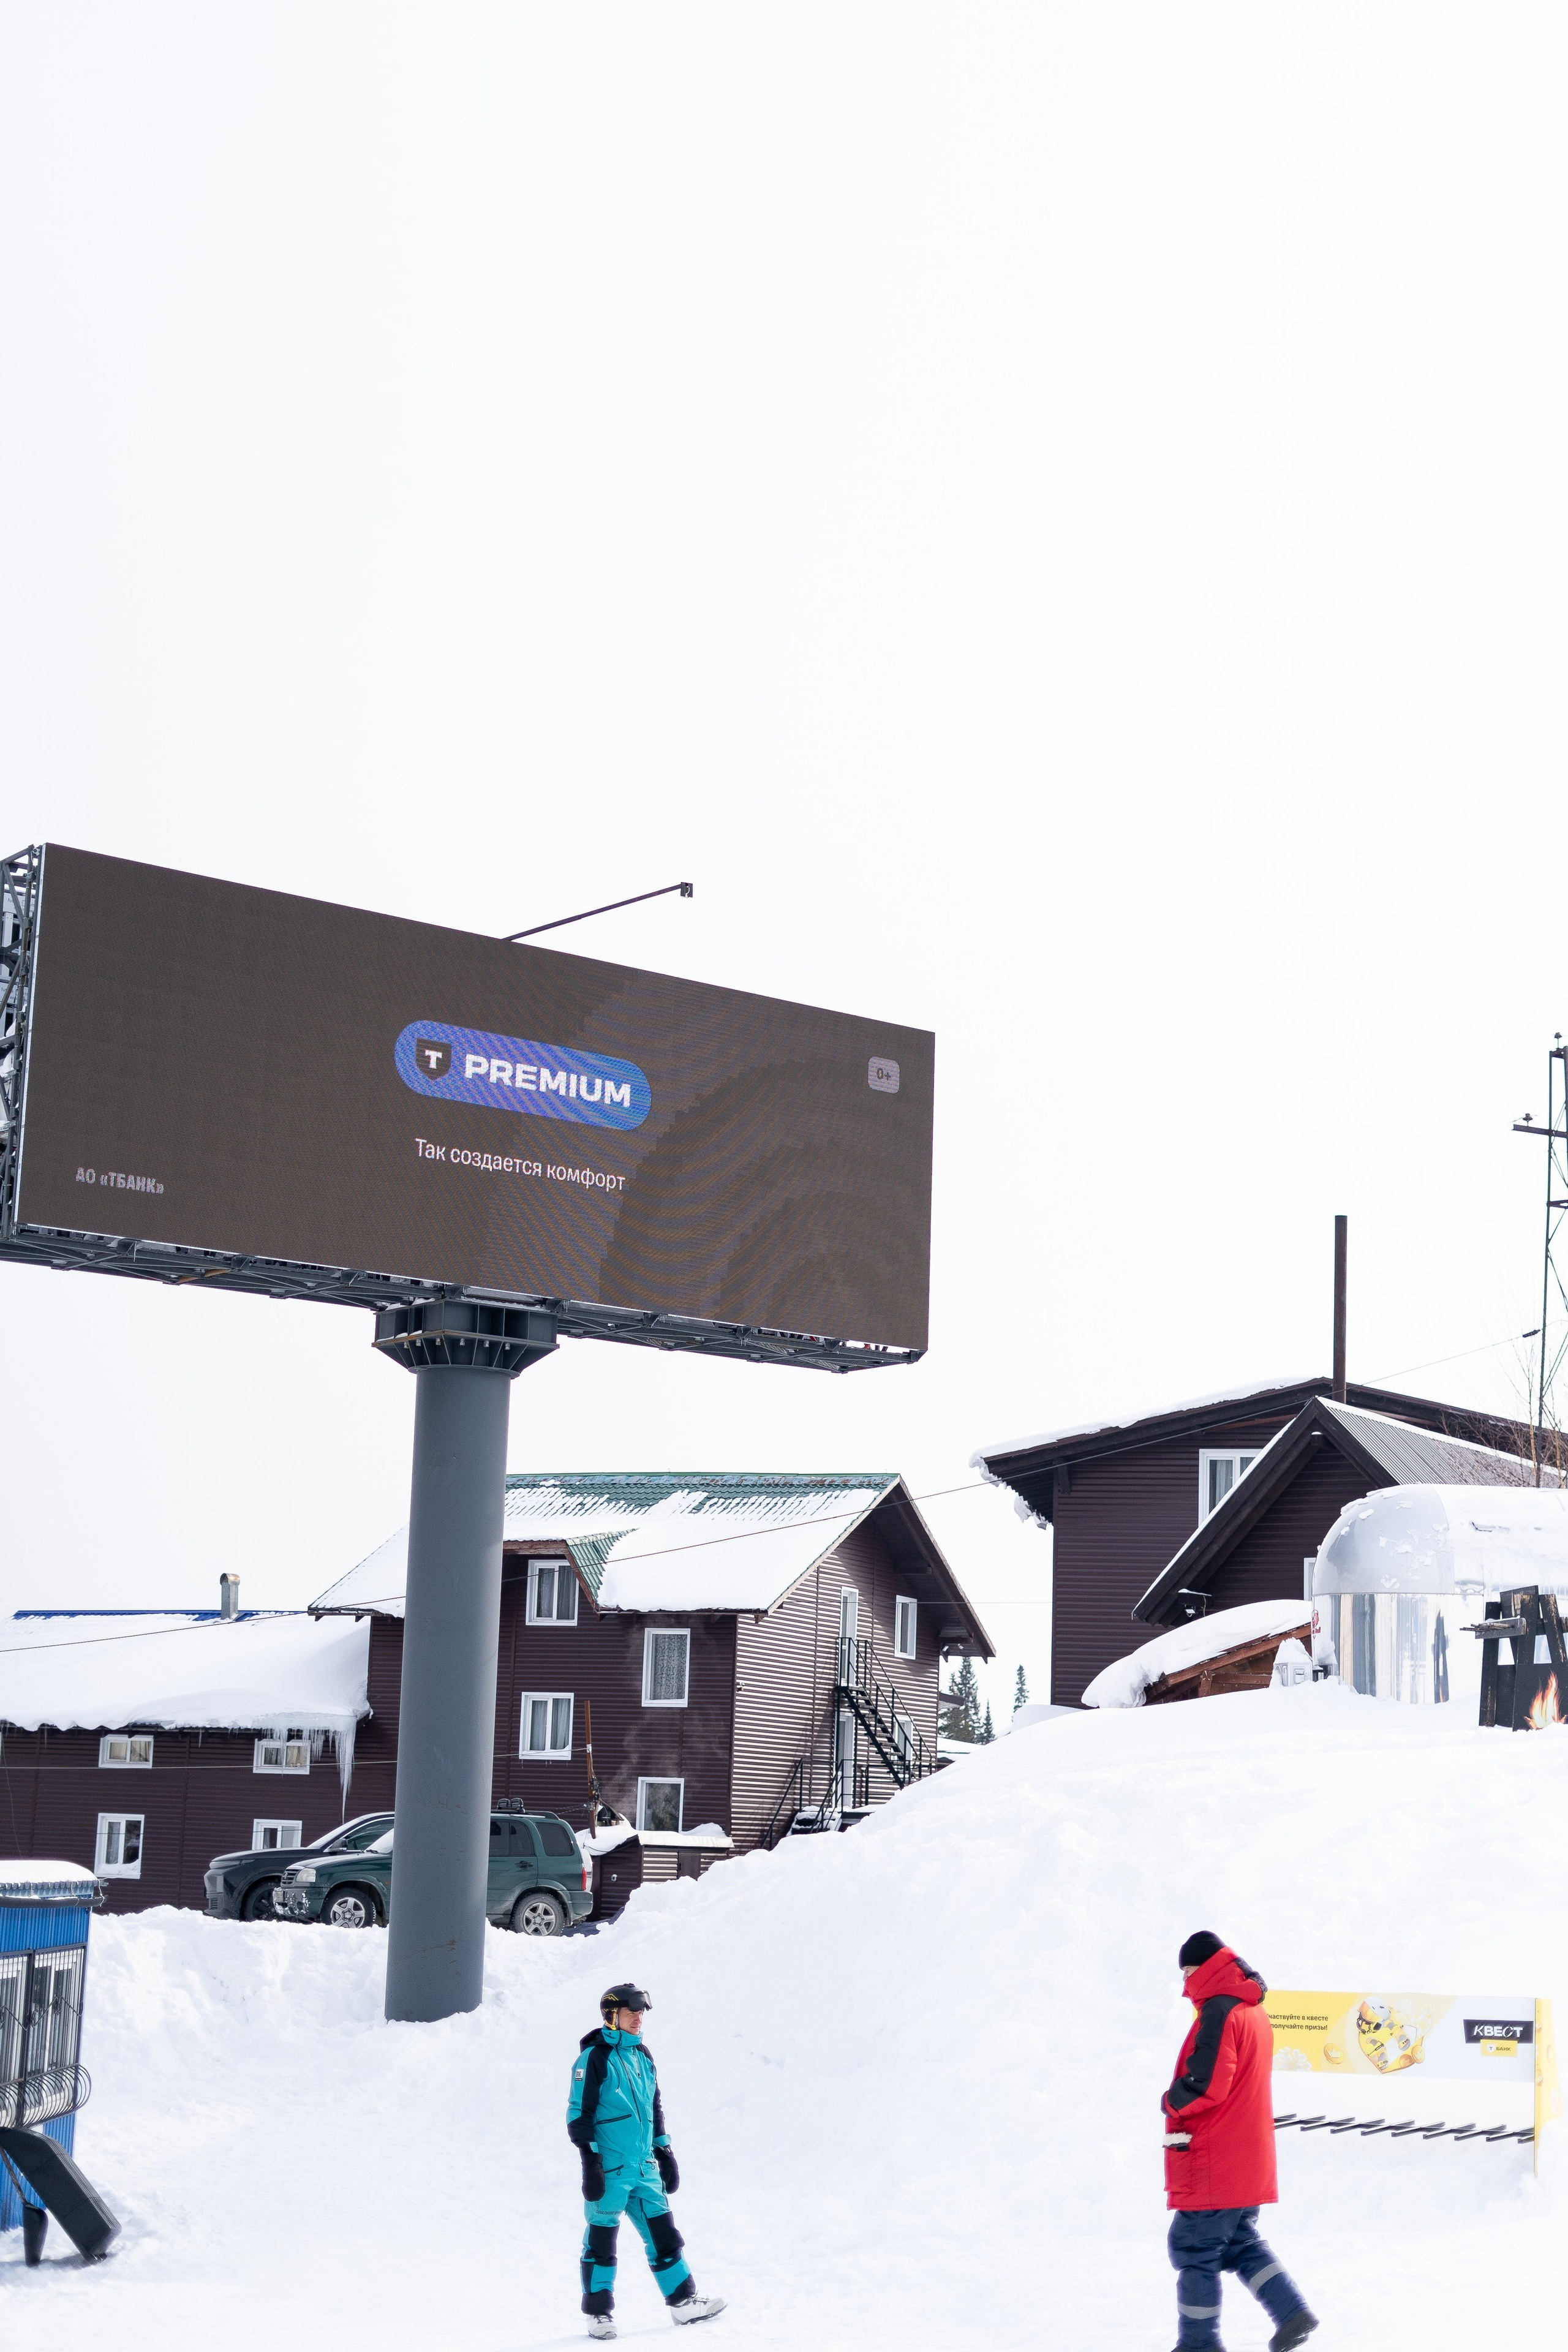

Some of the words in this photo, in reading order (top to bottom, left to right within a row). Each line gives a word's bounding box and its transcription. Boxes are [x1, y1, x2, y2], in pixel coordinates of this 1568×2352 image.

[464, 1054, 631, 1107] PREMIUM
[876, 1068, 892, 1081] 0+
[415, 1138, 446, 1161] Так
[450, 1148, 542, 1177] создается
[547, 1164, 626, 1192] комфорт
[75, 1167, 96, 1185] АО
[1473, 2025, 1523, 2038] КВЕСТ
